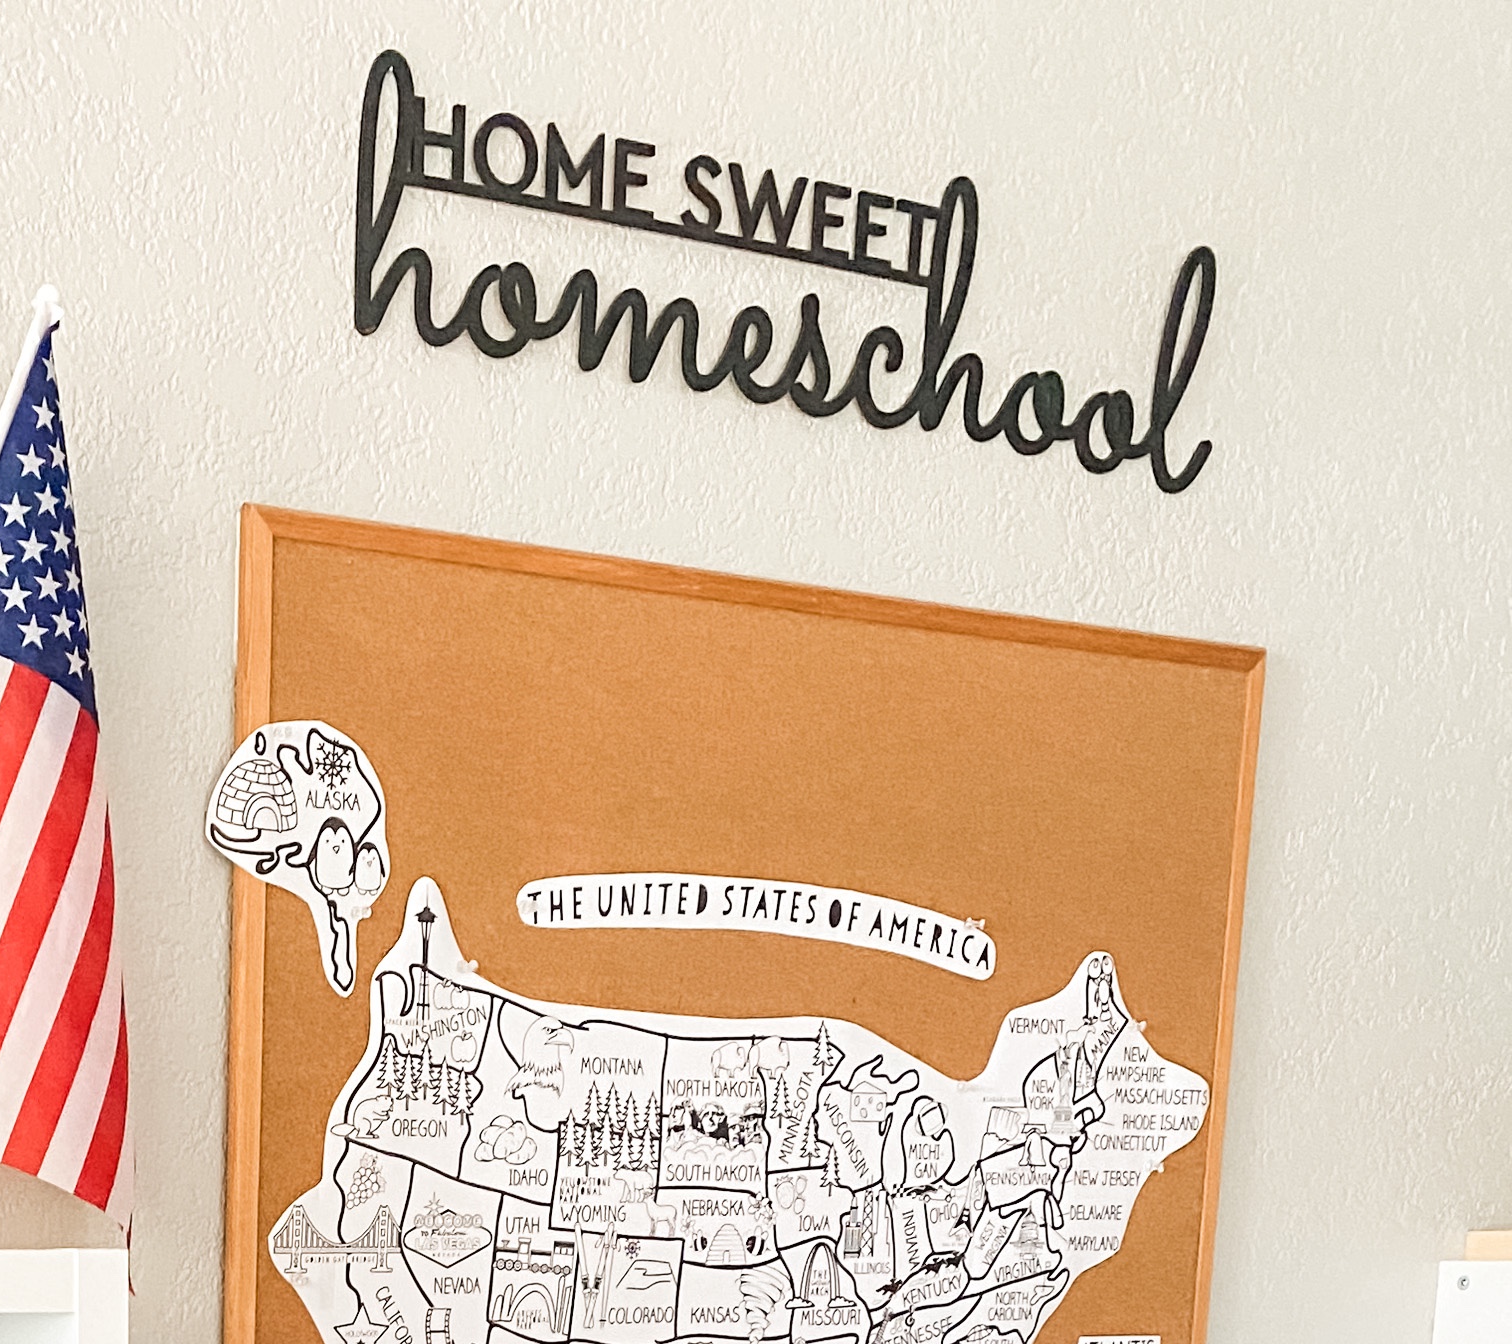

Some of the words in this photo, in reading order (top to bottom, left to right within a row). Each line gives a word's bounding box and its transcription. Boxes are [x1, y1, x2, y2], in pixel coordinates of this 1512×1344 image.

[409, 95, 655, 219] HOME
[680, 155, 938, 280] SWEET
[354, 49, 1212, 494] homeschool
[305, 790, 360, 812] ALASKA
[527, 886, 582, 924] THE
[598, 883, 708, 917] UNITED
[723, 885, 817, 923] STATES
[829, 899, 861, 932] OF
[868, 909, 989, 971] AMERICA
[401, 1006, 487, 1049] WASHINGTON
[1009, 1018, 1066, 1034] VERMONT
[1091, 1021, 1119, 1057] MAINE
[1124, 1047, 1149, 1063] NEW
[581, 1057, 644, 1075] MONTANA
[1107, 1067, 1166, 1083] HAMPSHIRE
[667, 1079, 710, 1097] NORTH
[715, 1080, 762, 1097] DAKOTA
[1032, 1080, 1056, 1093] NEW
[1029, 1097, 1054, 1109] YORK
[1115, 1089, 1208, 1105] MASSACHUSETTS
[779, 1071, 814, 1163] MINNESOTA
[1123, 1114, 1156, 1130] RHODE
[1161, 1115, 1200, 1130] ISLAND
[392, 1119, 448, 1137] OREGON
[824, 1093, 869, 1178] WISCONSIN
[1094, 1135, 1167, 1151] CONNECTICUT
[509, 1169, 549, 1186] IDAHO
[666, 1165, 710, 1181] SOUTH
[715, 1165, 762, 1181] DAKOTA
[986, 1172, 1052, 1185] PENNSYLVANIA
[1074, 1171, 1098, 1185] NEW
[1103, 1171, 1141, 1187] JERSEY
[561, 1205, 627, 1223] WYOMING
[683, 1200, 744, 1216] NEBRASKA
[930, 1203, 959, 1225] OHIO
[1070, 1205, 1123, 1221] DELAWARE
[506, 1217, 540, 1234] UTAH
[799, 1215, 830, 1232] IOWA
[902, 1210, 921, 1270] INDIANA
[1069, 1237, 1119, 1251] MARYLAND
[994, 1258, 1042, 1283] VIRGINIA
[434, 1277, 481, 1294] NEVADA
[902, 1273, 963, 1308] KENTUCKY
[996, 1291, 1029, 1305] NORTH
[608, 1307, 674, 1324] COLORADO
[691, 1306, 740, 1323] KANSAS
[801, 1309, 860, 1326] MISSOURI
[989, 1307, 1033, 1321] CAROLINA
